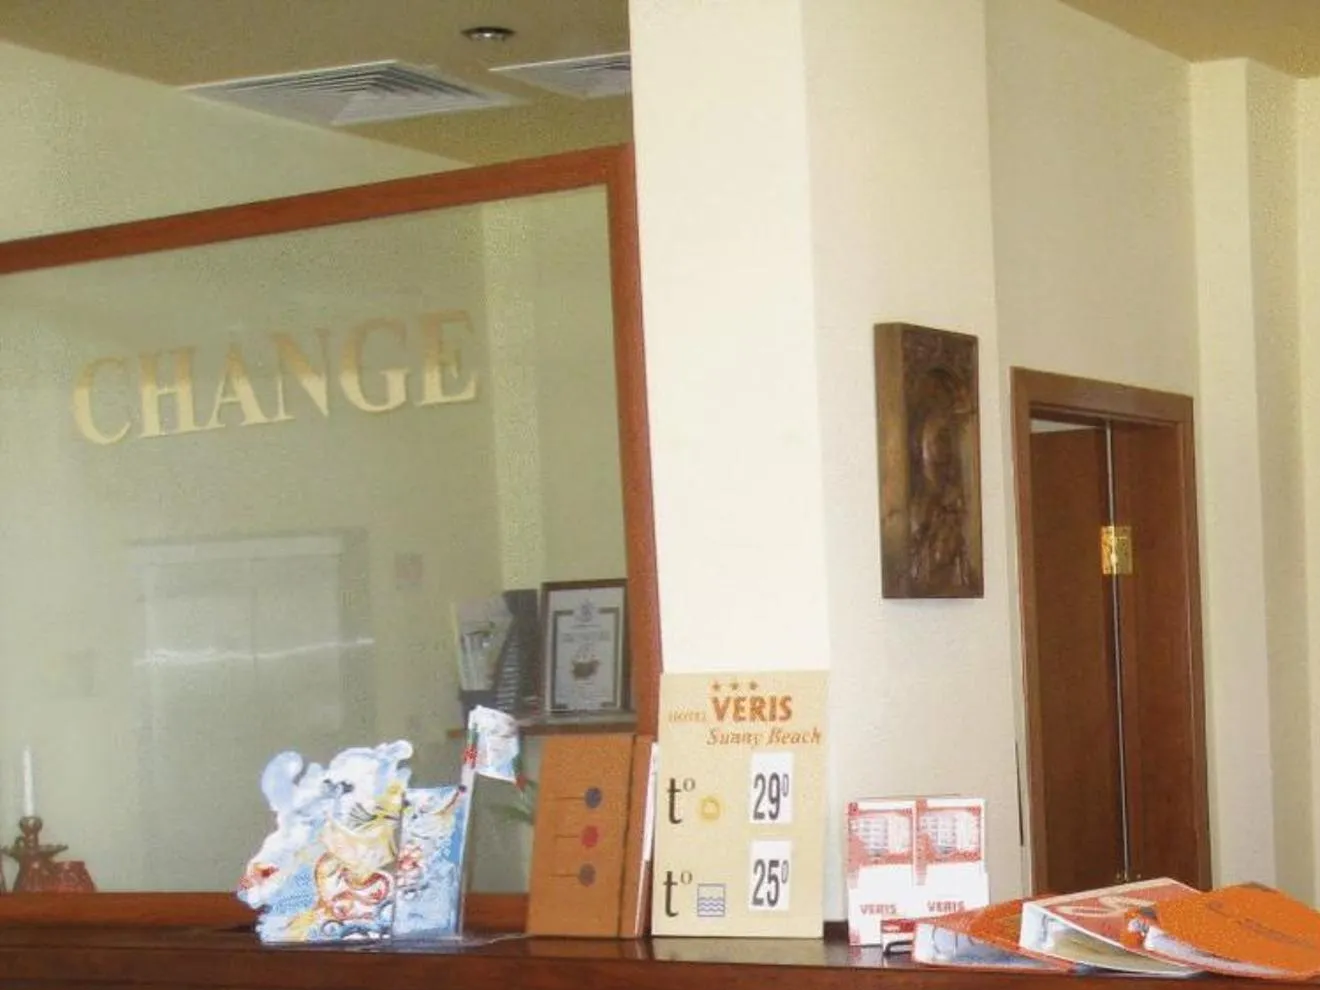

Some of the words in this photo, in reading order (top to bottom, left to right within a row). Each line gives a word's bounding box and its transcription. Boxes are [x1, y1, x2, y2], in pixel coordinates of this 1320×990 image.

[73, 309, 480, 445] CHANGE
[711, 695, 793, 722] VERIS
[767, 726, 822, 746] Beach
